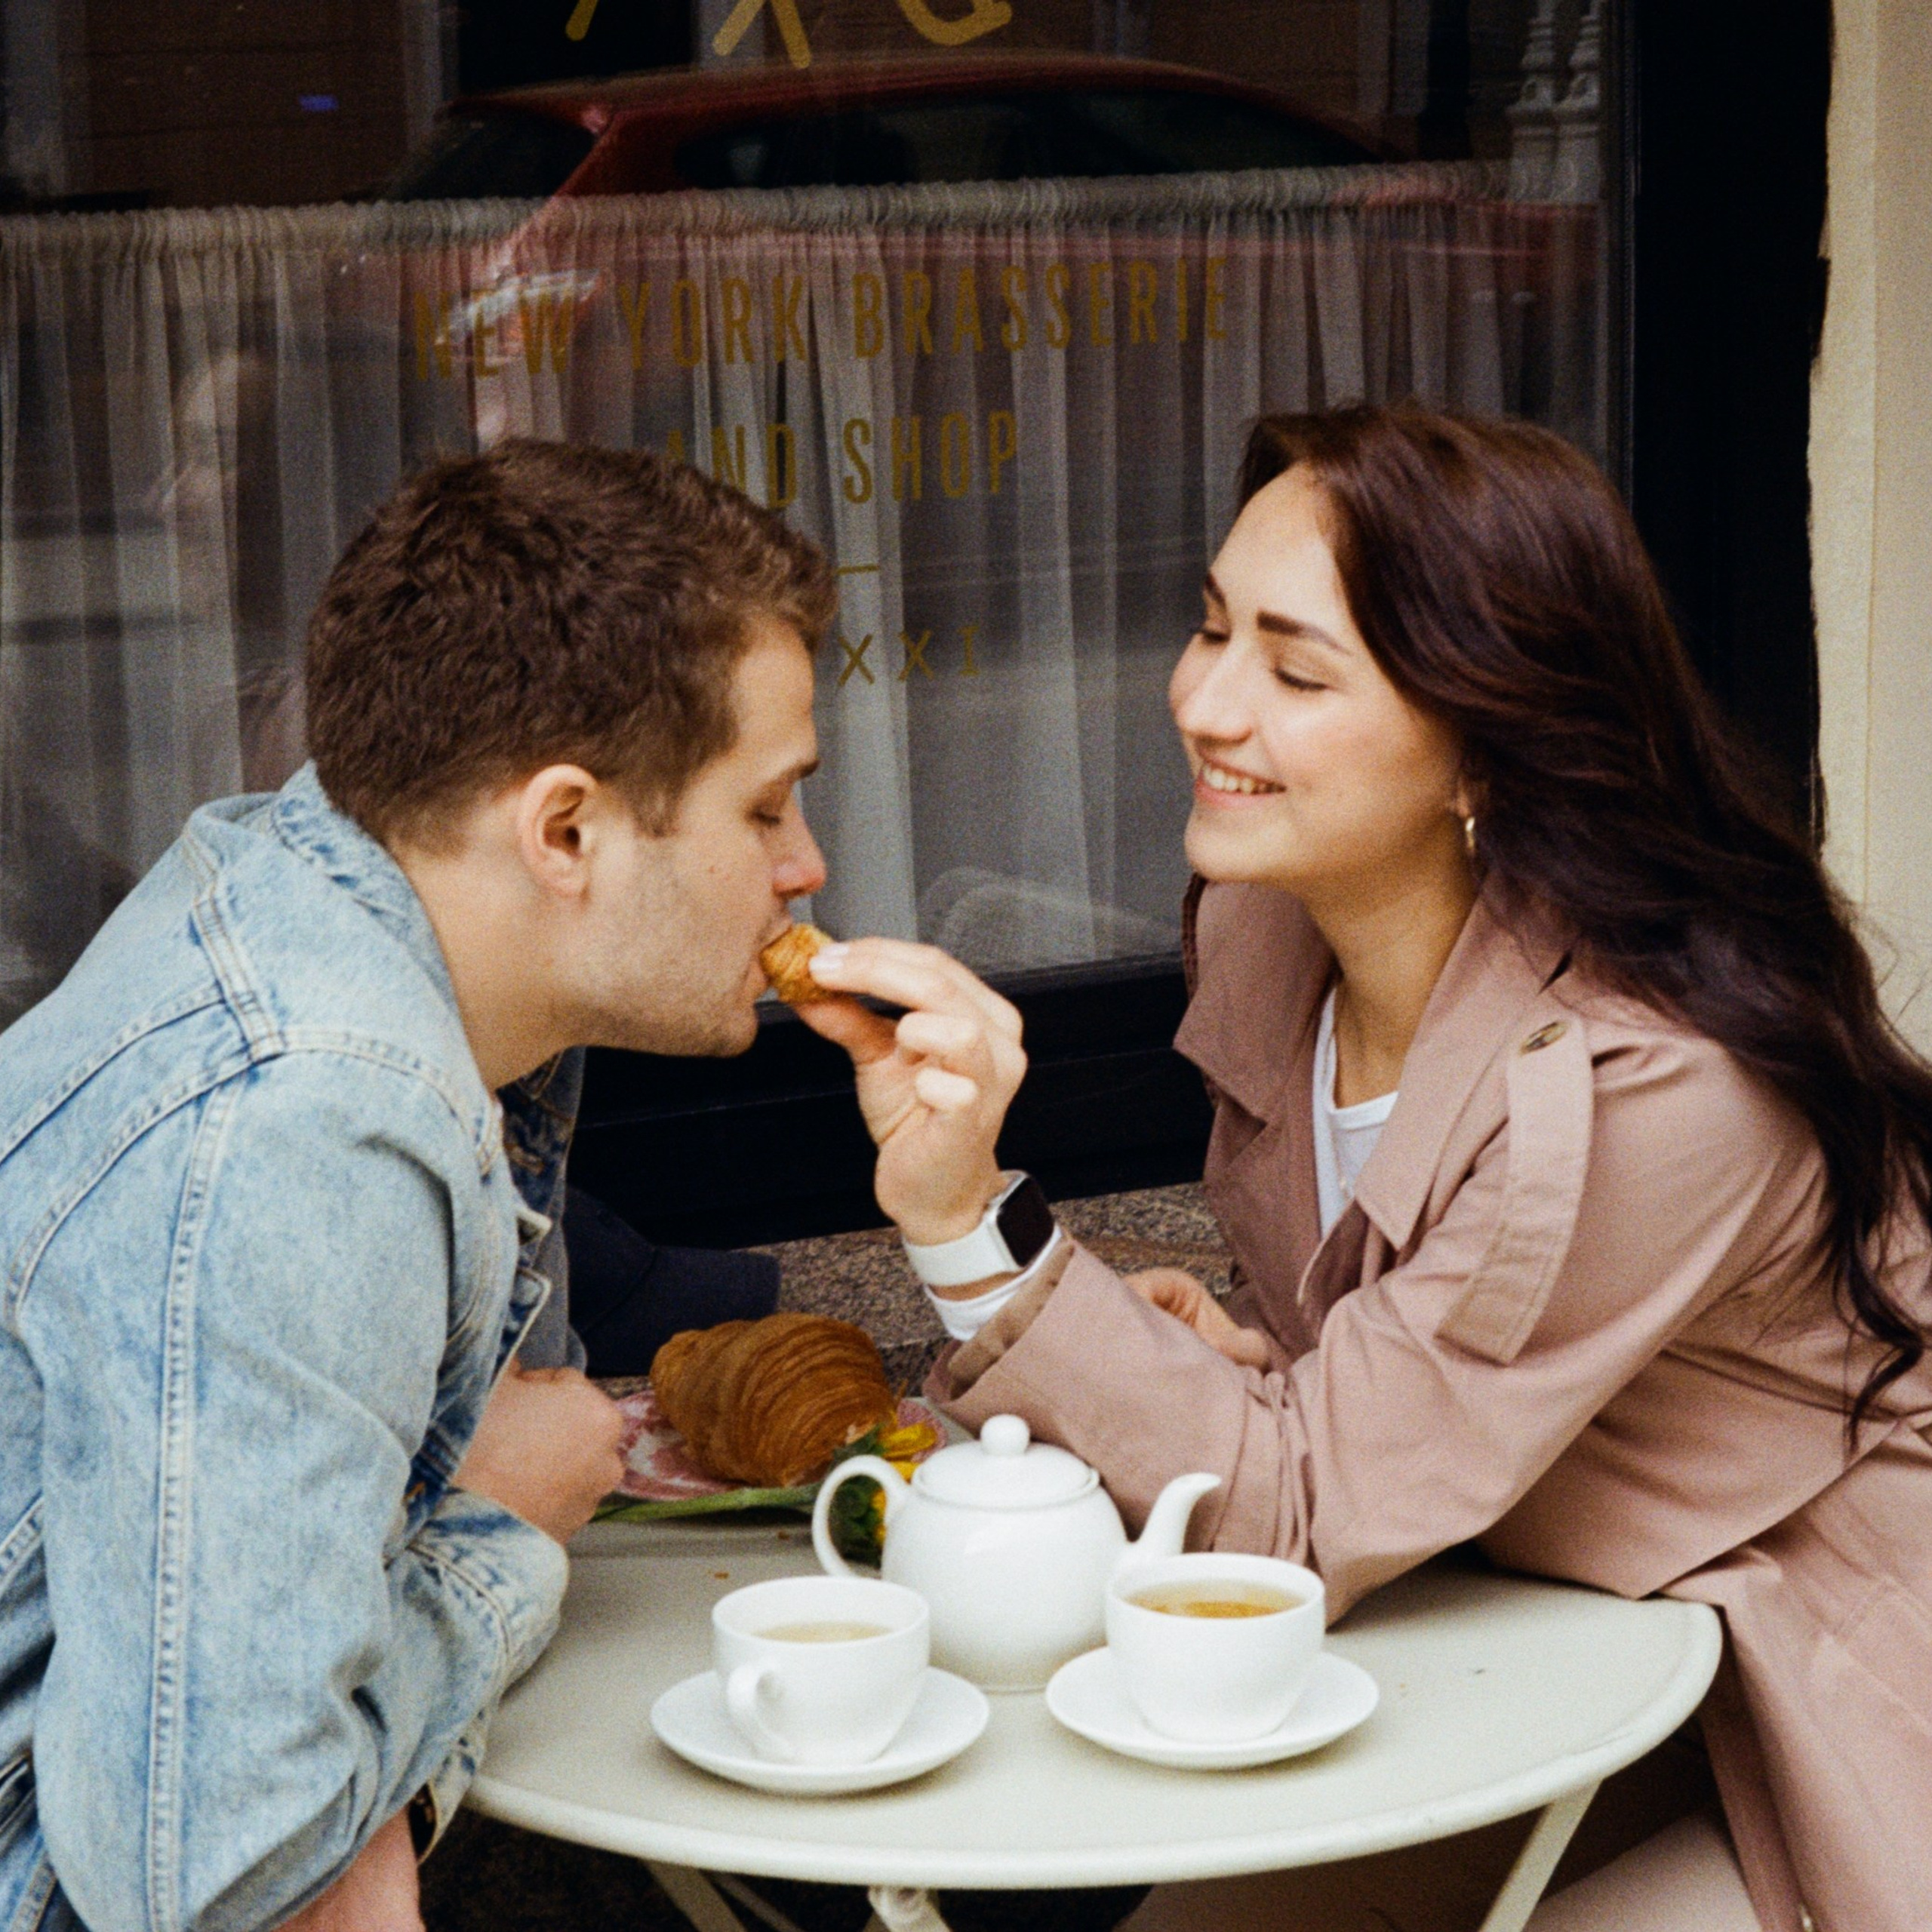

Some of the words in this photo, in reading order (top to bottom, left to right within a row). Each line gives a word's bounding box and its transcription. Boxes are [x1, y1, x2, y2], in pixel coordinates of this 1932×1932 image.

[414, 290, 571, 380] NEW
[619, 275, 806, 371] YORK
[853, 257, 1228, 358] BRASSERIE
[842, 410, 1017, 504] SHOP
